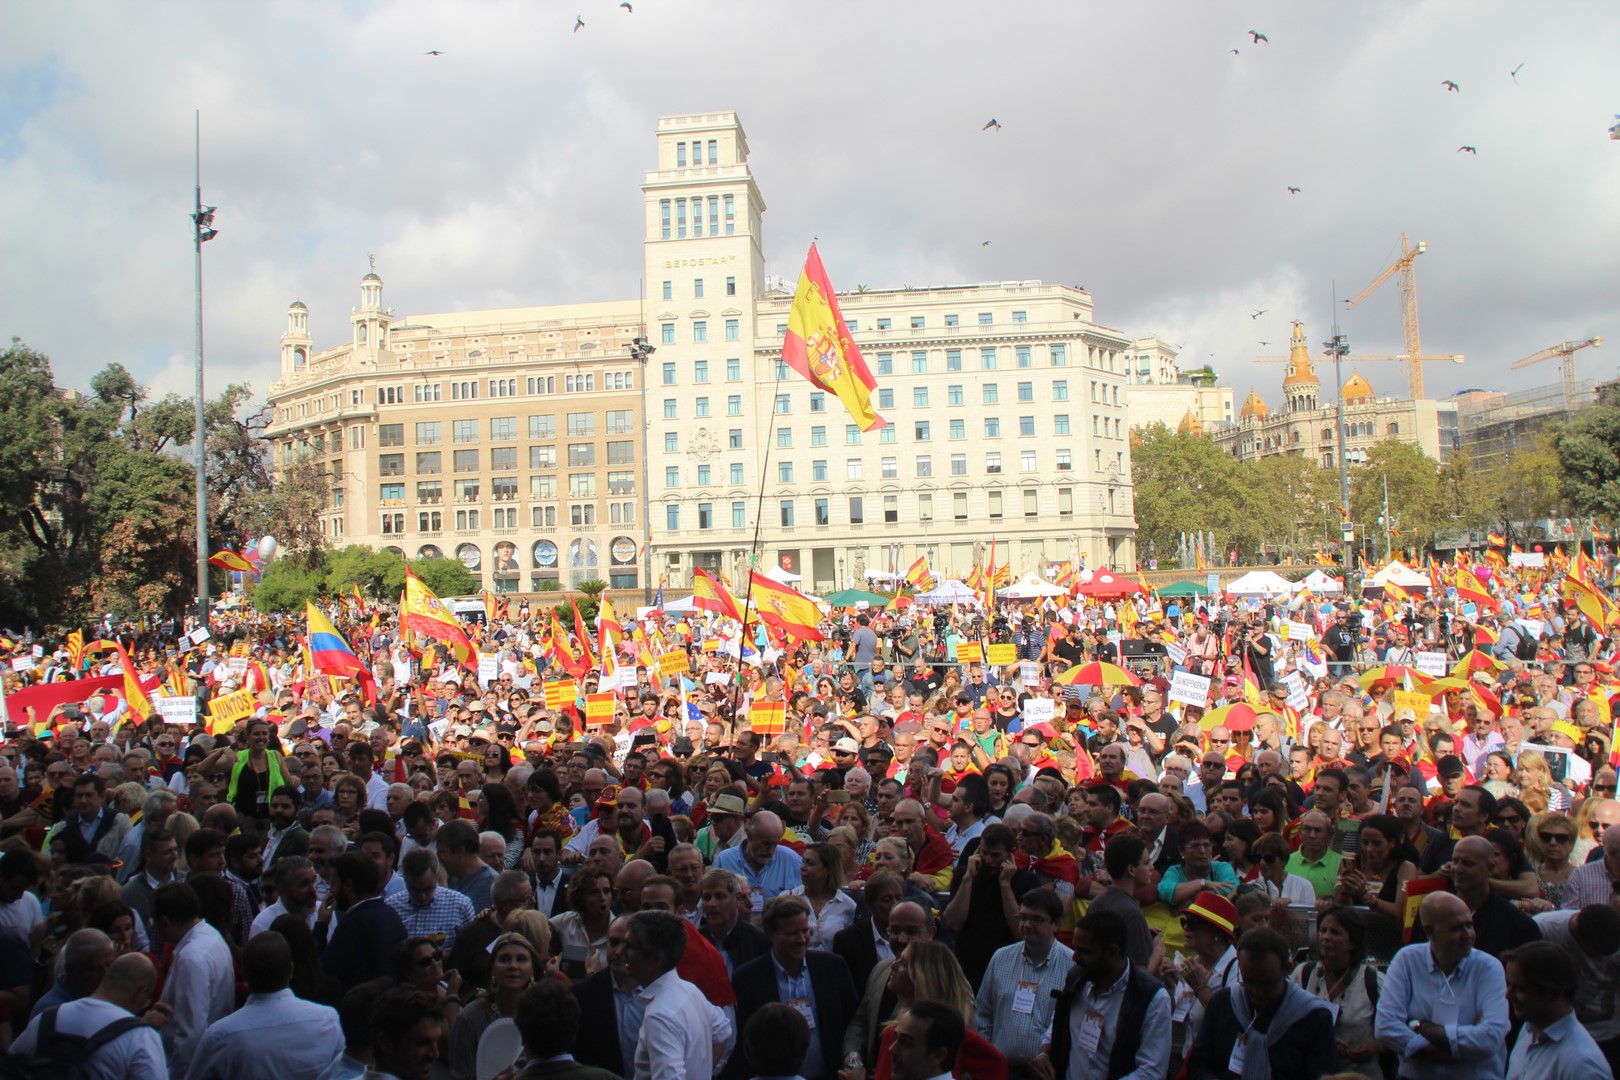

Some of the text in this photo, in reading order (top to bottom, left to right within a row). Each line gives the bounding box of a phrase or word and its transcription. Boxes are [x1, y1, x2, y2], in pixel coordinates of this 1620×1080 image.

[215, 693, 251, 721] JUNTOS
[596, 704, 611, 713] TODOS
[1033, 706, 1051, 715] LENGUA
[754, 713, 780, 722] DE TODOS
